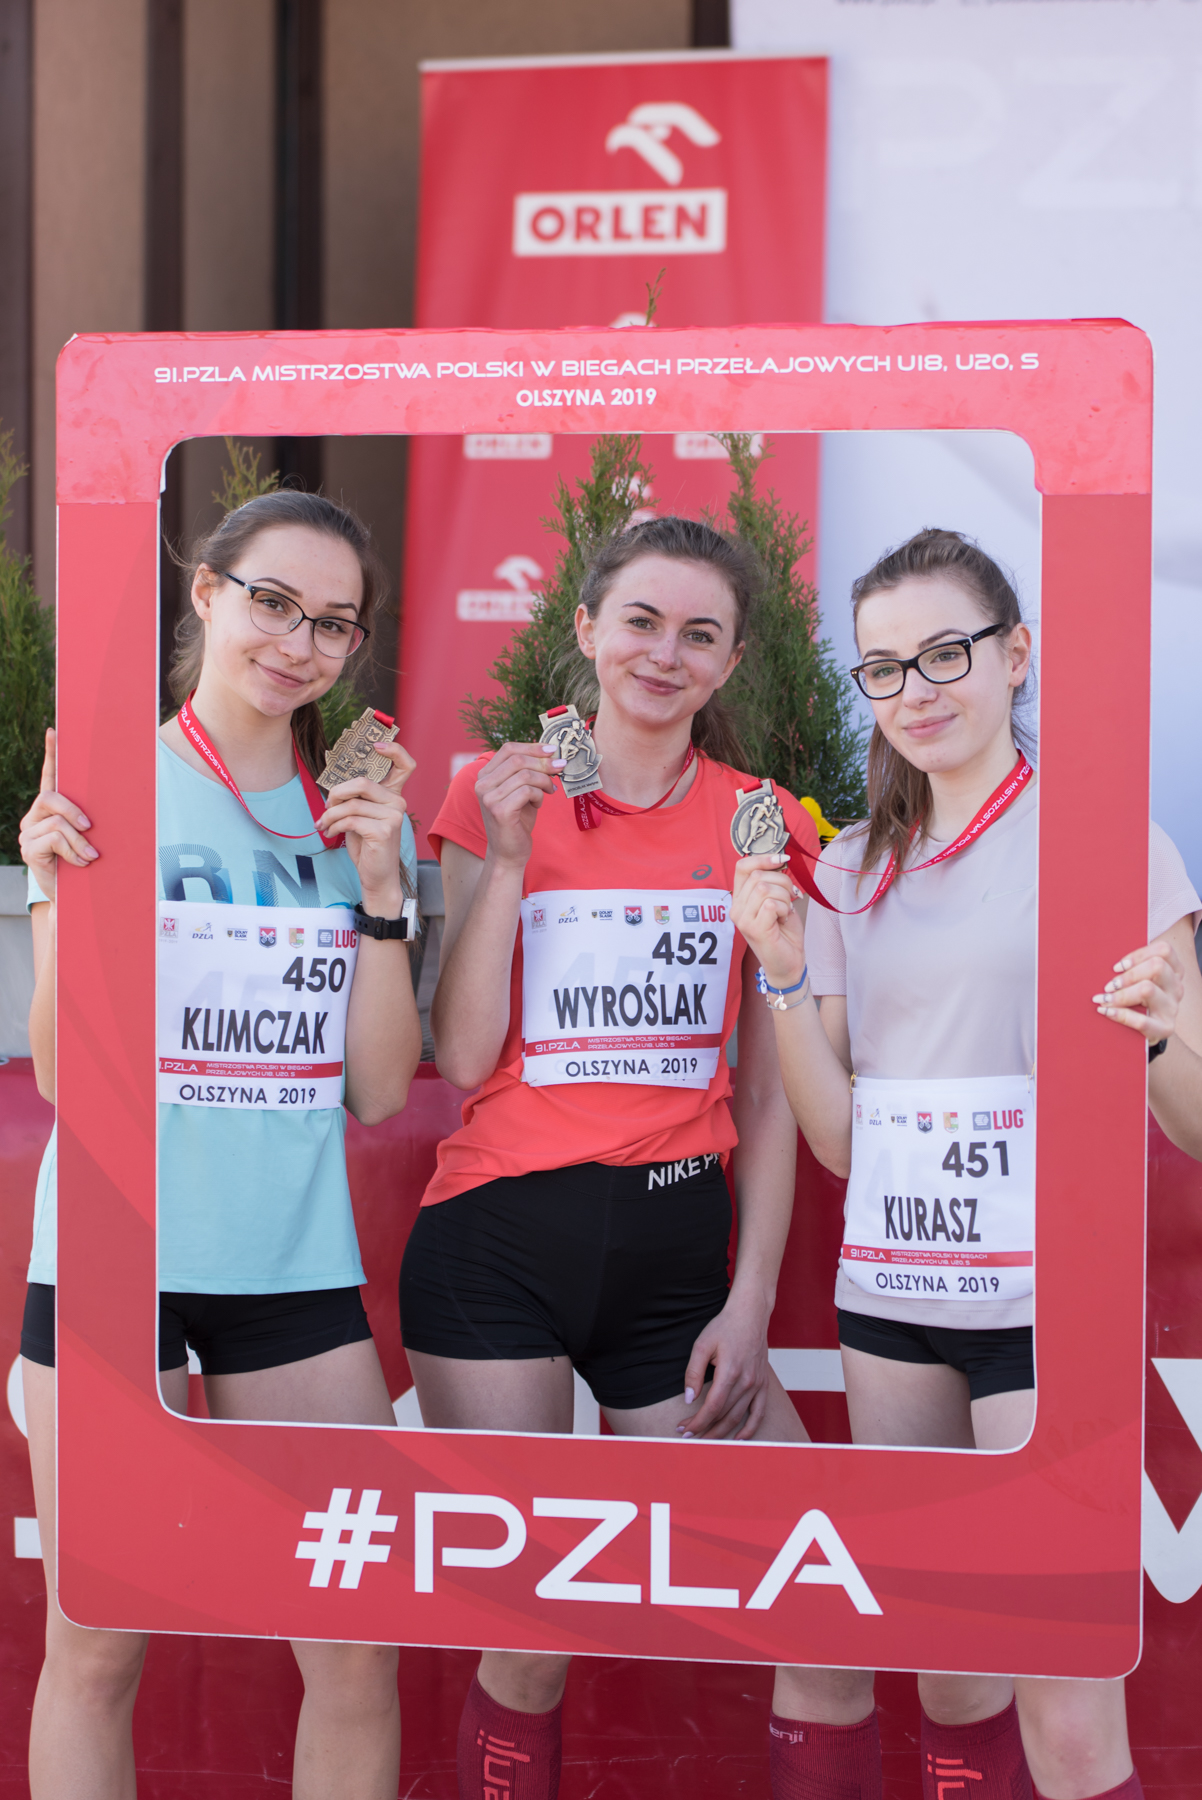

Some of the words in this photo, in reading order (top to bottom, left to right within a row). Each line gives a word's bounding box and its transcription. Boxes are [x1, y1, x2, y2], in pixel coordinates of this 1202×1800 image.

[531, 203, 707, 243] ORLEN
[154, 366, 247, 383] 91.PZLA
[251, 363, 432, 381] MISTRZOSTWA
[436, 361, 524, 378] POLSKI
[530, 360, 556, 377] W
[561, 358, 671, 377] BIEGACH
[677, 356, 891, 375] PRZEŁAJOWYCH
[898, 354, 948, 373] U18,
[955, 353, 1014, 371] U20,
[1020, 353, 1039, 370] S
[516, 389, 606, 407] OLSZYNA
[610, 388, 657, 405] 2019
[700, 905, 726, 922] LUG
[335, 930, 357, 948] LUG
[652, 932, 718, 965] 452
[282, 956, 346, 993] 450
[554, 971, 708, 1030] WYROŚLAK
[182, 1006, 328, 1054] KLIMCZAK
[535, 1041, 580, 1052] 91.PZLA
[566, 1058, 650, 1077] OLSZYNA
[661, 1057, 698, 1074] 2019
[180, 1084, 267, 1104] OLSZYNA
[278, 1088, 316, 1104] 2019
[993, 1109, 1024, 1130] LUG
[648, 1156, 700, 1190] NIKE
[942, 1140, 1009, 1178] 451
[884, 1196, 981, 1243] KURASZ
[876, 1272, 948, 1292] OLSZYNA
[958, 1277, 1000, 1293] 2019
[294, 1488, 884, 1615] #PZLA
